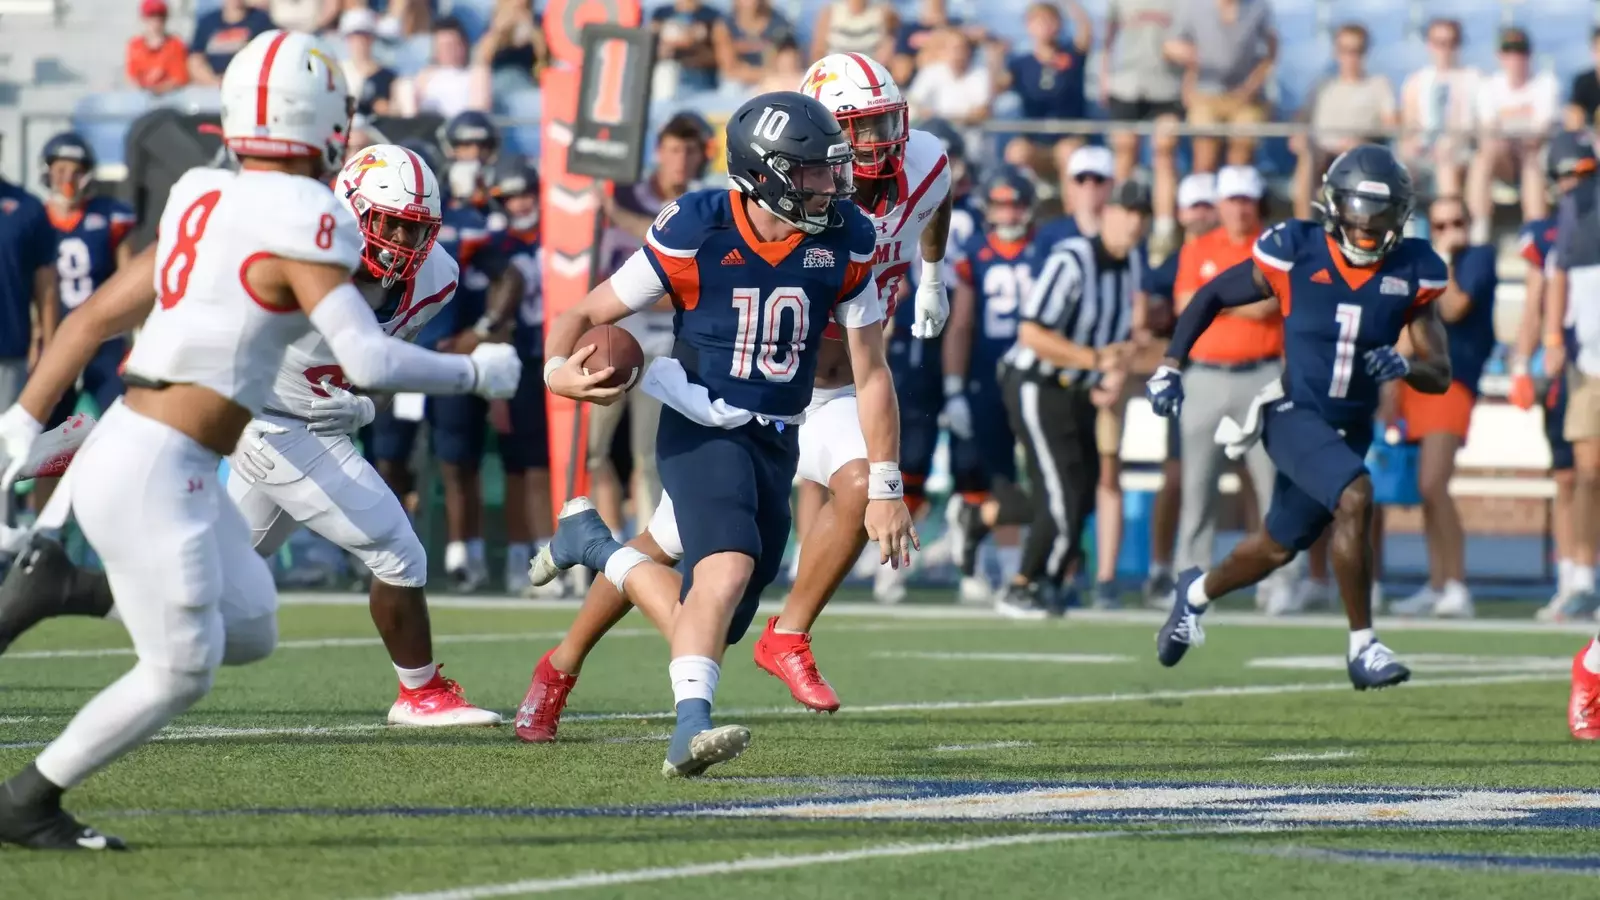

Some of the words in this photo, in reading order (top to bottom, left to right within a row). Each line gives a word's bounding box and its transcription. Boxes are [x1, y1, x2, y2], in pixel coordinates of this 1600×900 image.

[592, 37, 628, 125] 1
[753, 106, 791, 141] 10
[160, 189, 222, 311] 8
[315, 213, 336, 250] 8
[874, 240, 902, 264] MI
[729, 286, 811, 383] 10
[1328, 303, 1362, 398] 1
